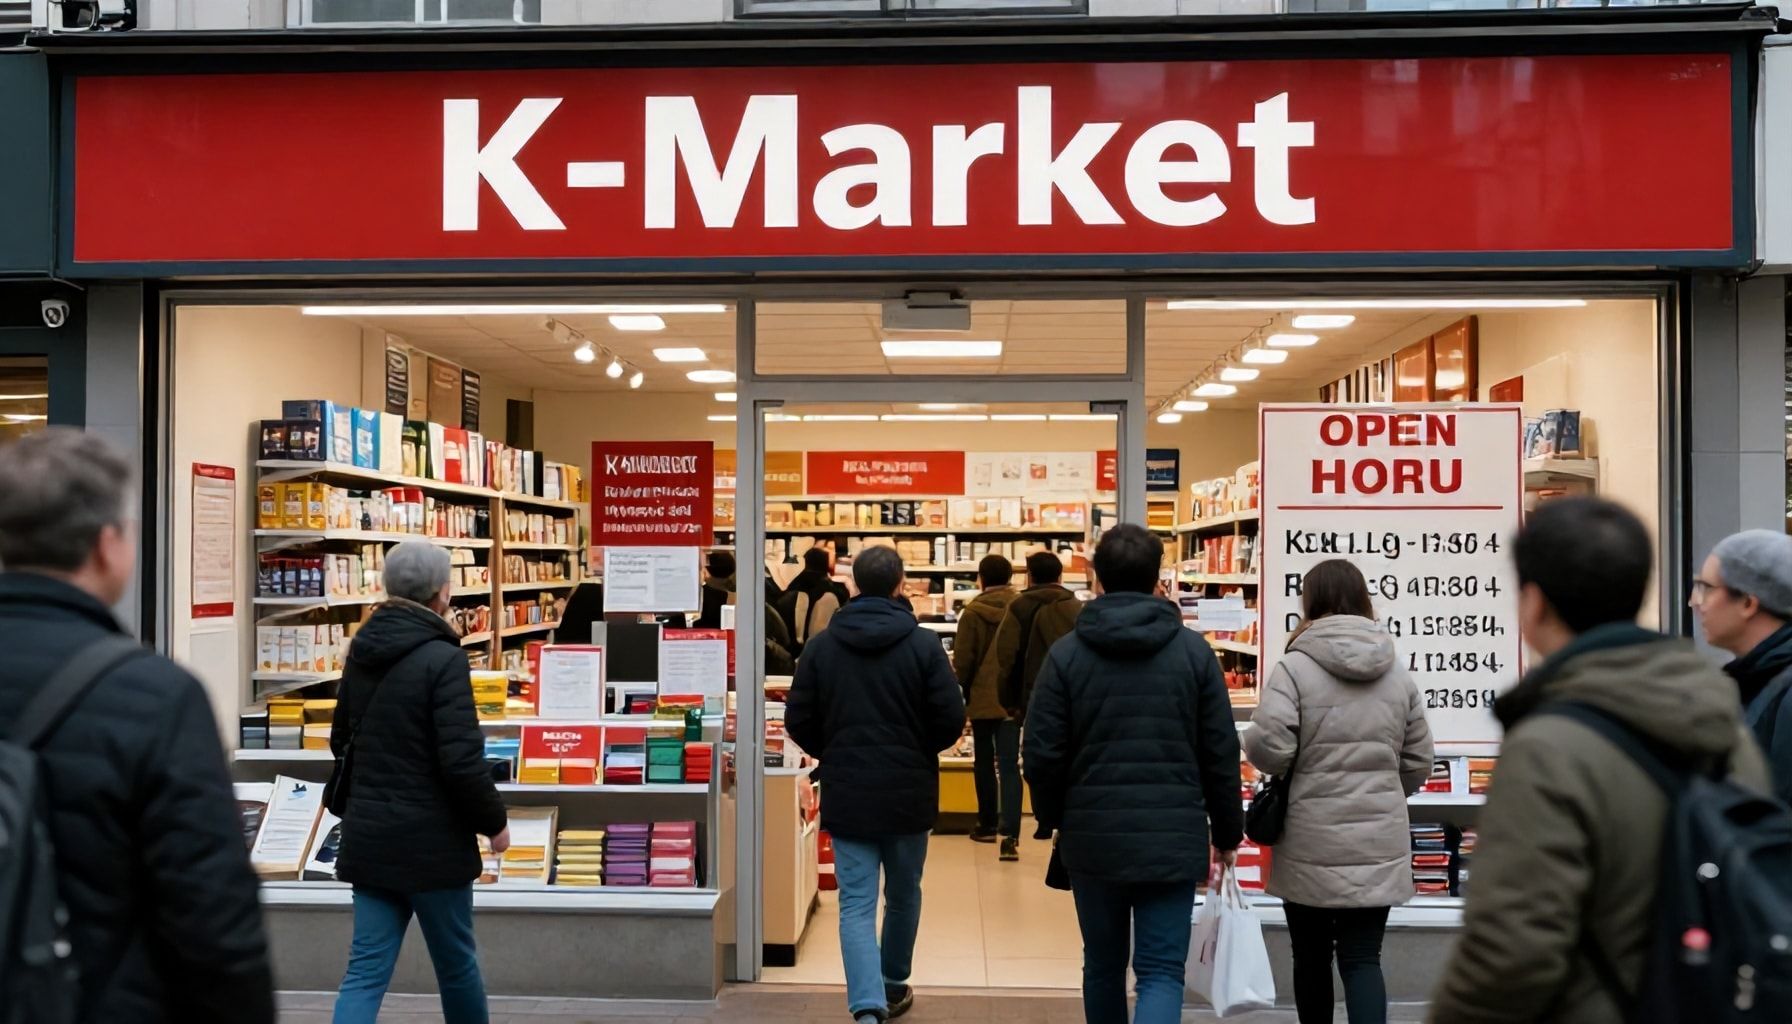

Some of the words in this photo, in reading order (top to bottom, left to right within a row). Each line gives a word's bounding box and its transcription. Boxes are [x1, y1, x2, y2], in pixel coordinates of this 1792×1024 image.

[442, 85, 1317, 232] K-Market
[1319, 413, 1458, 447] OPEN
[1310, 458, 1463, 495] HORU
